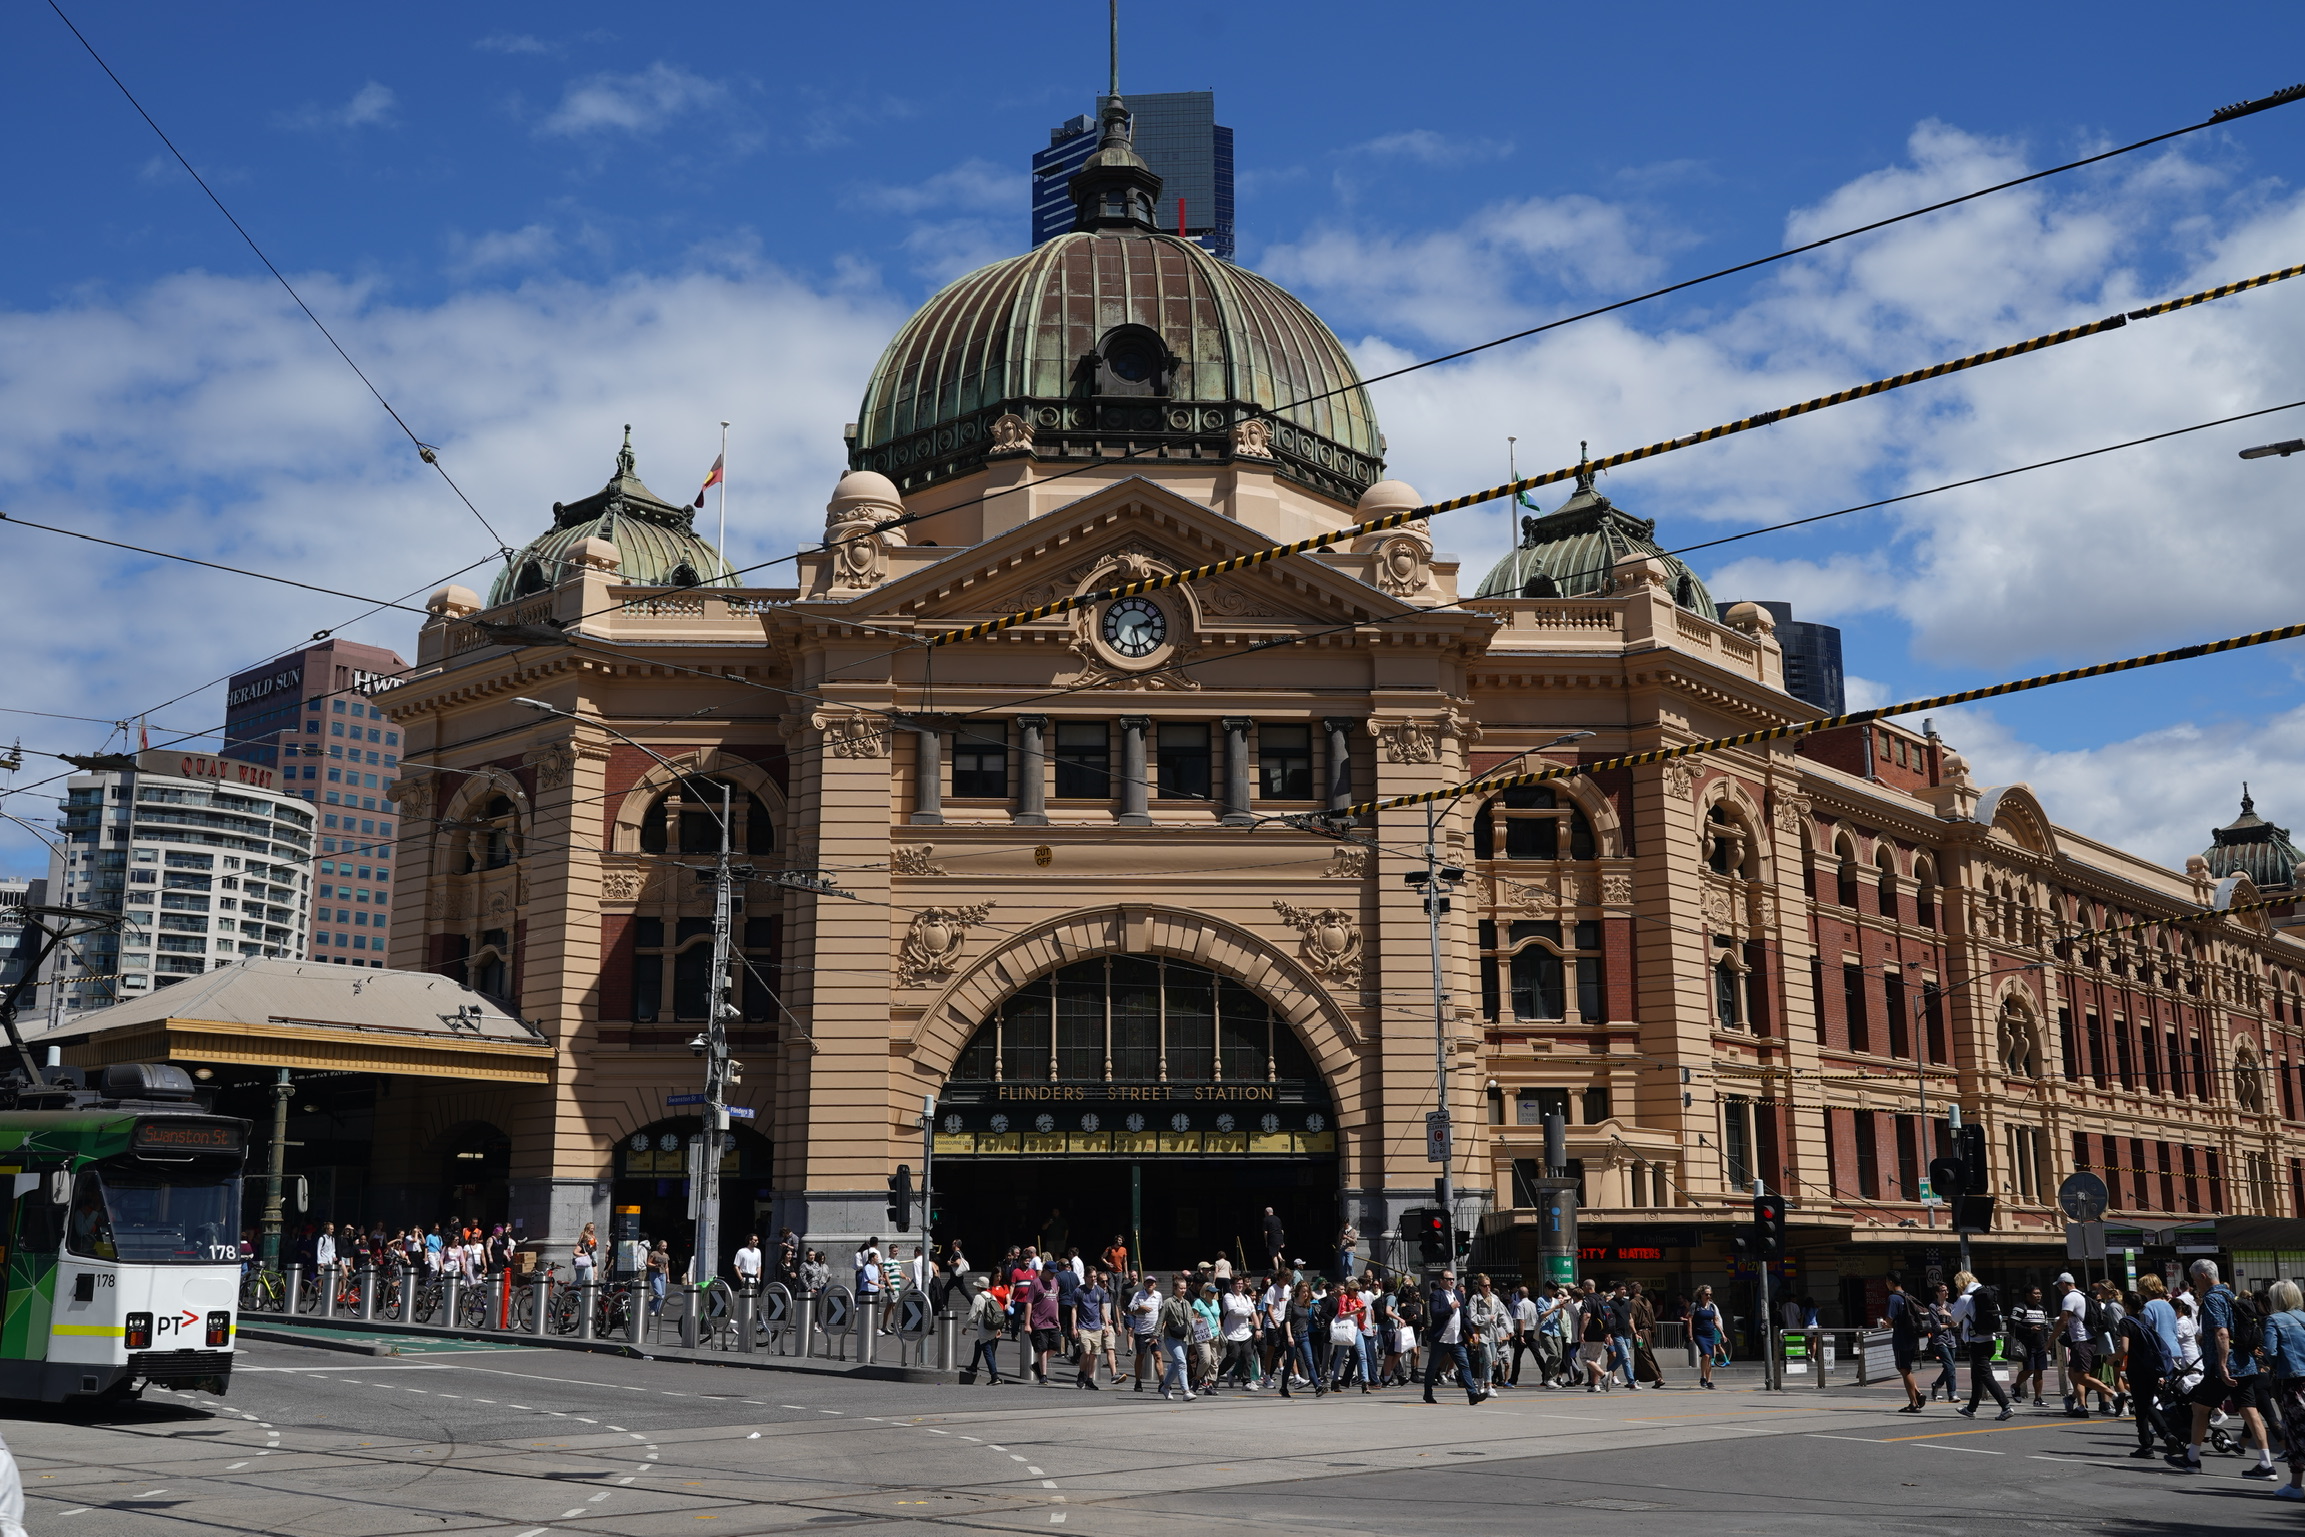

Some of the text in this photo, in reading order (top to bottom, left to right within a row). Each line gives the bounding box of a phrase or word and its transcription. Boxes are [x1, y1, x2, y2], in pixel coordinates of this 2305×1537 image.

[227, 668, 301, 708] HERALD SUN
[181, 756, 273, 789] QUAY WEST
[998, 1086, 1274, 1101] FLINDERS STREET STATION
[730, 1106, 747, 1115] Flinders
[144, 1125, 229, 1145] Swanston St
[209, 1245, 237, 1260] 178
[1618, 1248, 1662, 1259] HATTERS
[96, 1274, 116, 1288] 178
[1928, 1272, 1941, 1281] 40
